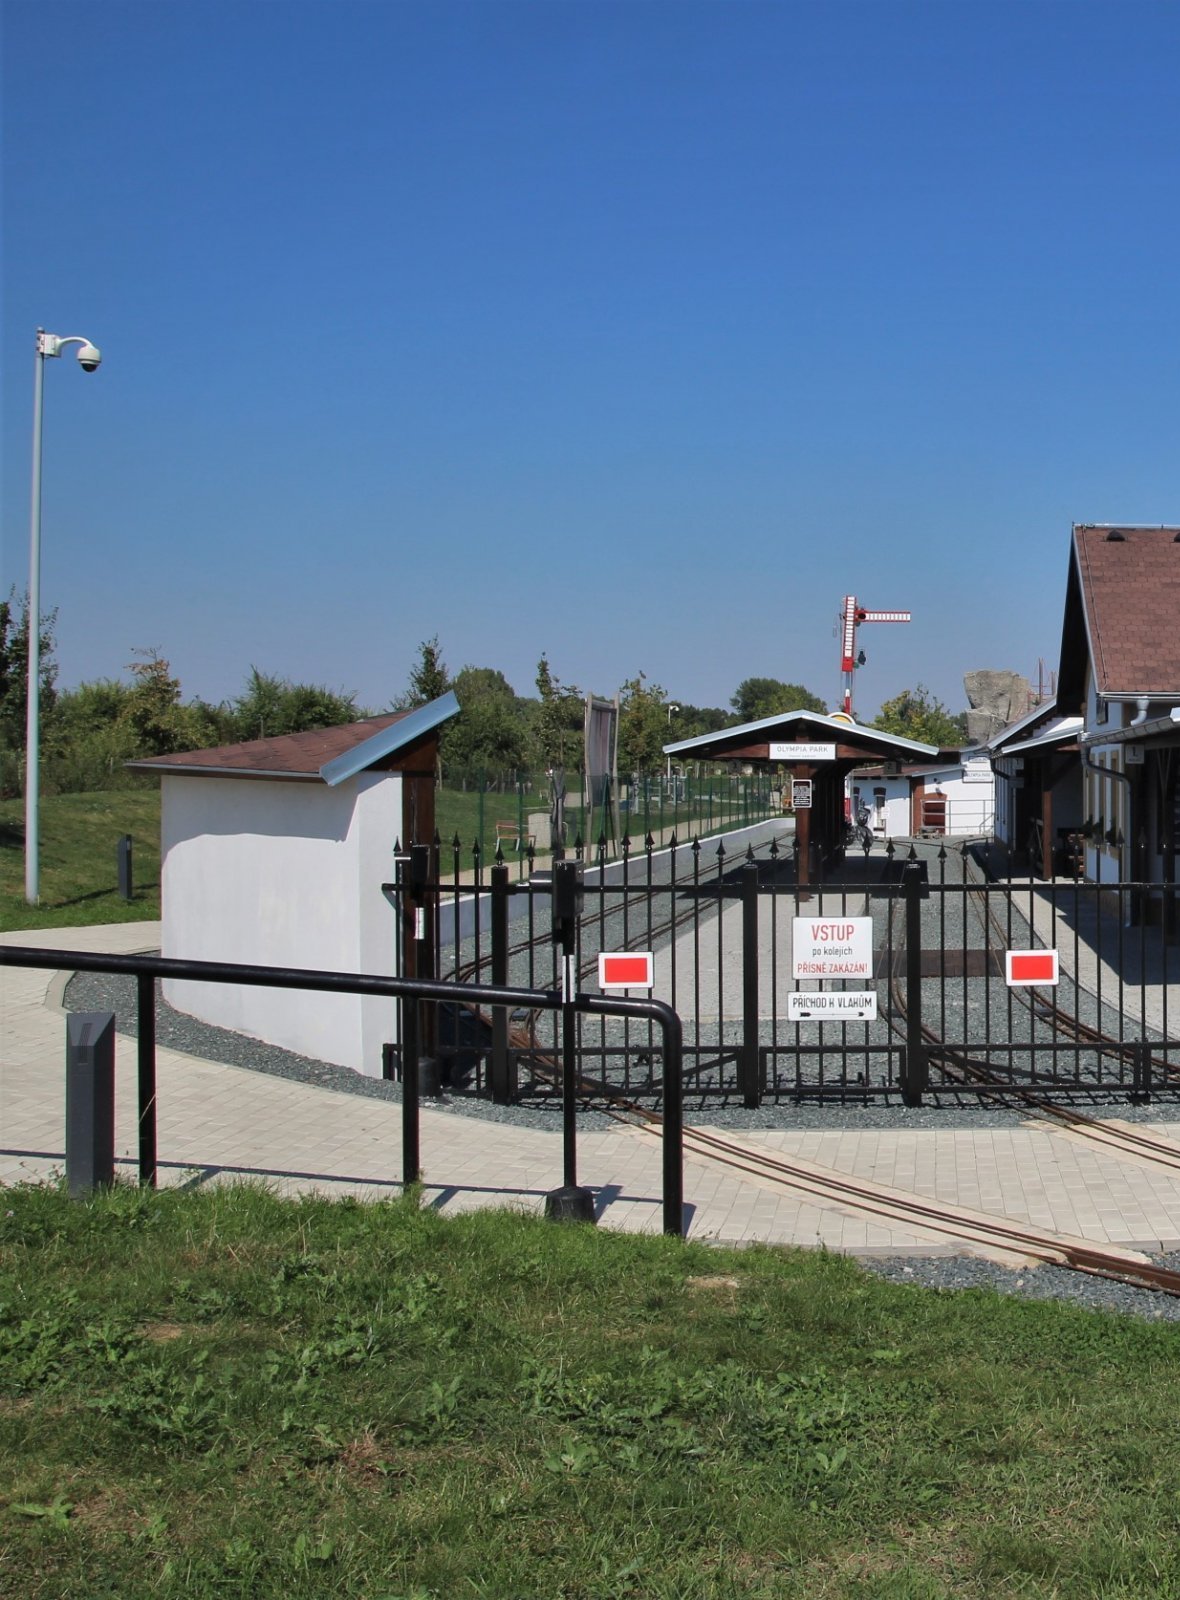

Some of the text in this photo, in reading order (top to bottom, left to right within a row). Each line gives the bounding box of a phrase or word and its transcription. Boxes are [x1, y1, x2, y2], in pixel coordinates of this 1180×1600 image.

[777, 745, 807, 753] OLYMPIA
[811, 924, 855, 942] VSTUP
[812, 948, 822, 958] po
[797, 961, 868, 974] PŘÍSNĚ ZAKÁZÁN!
[793, 994, 873, 1008] PŘÍCHOD K VLAKŮM
